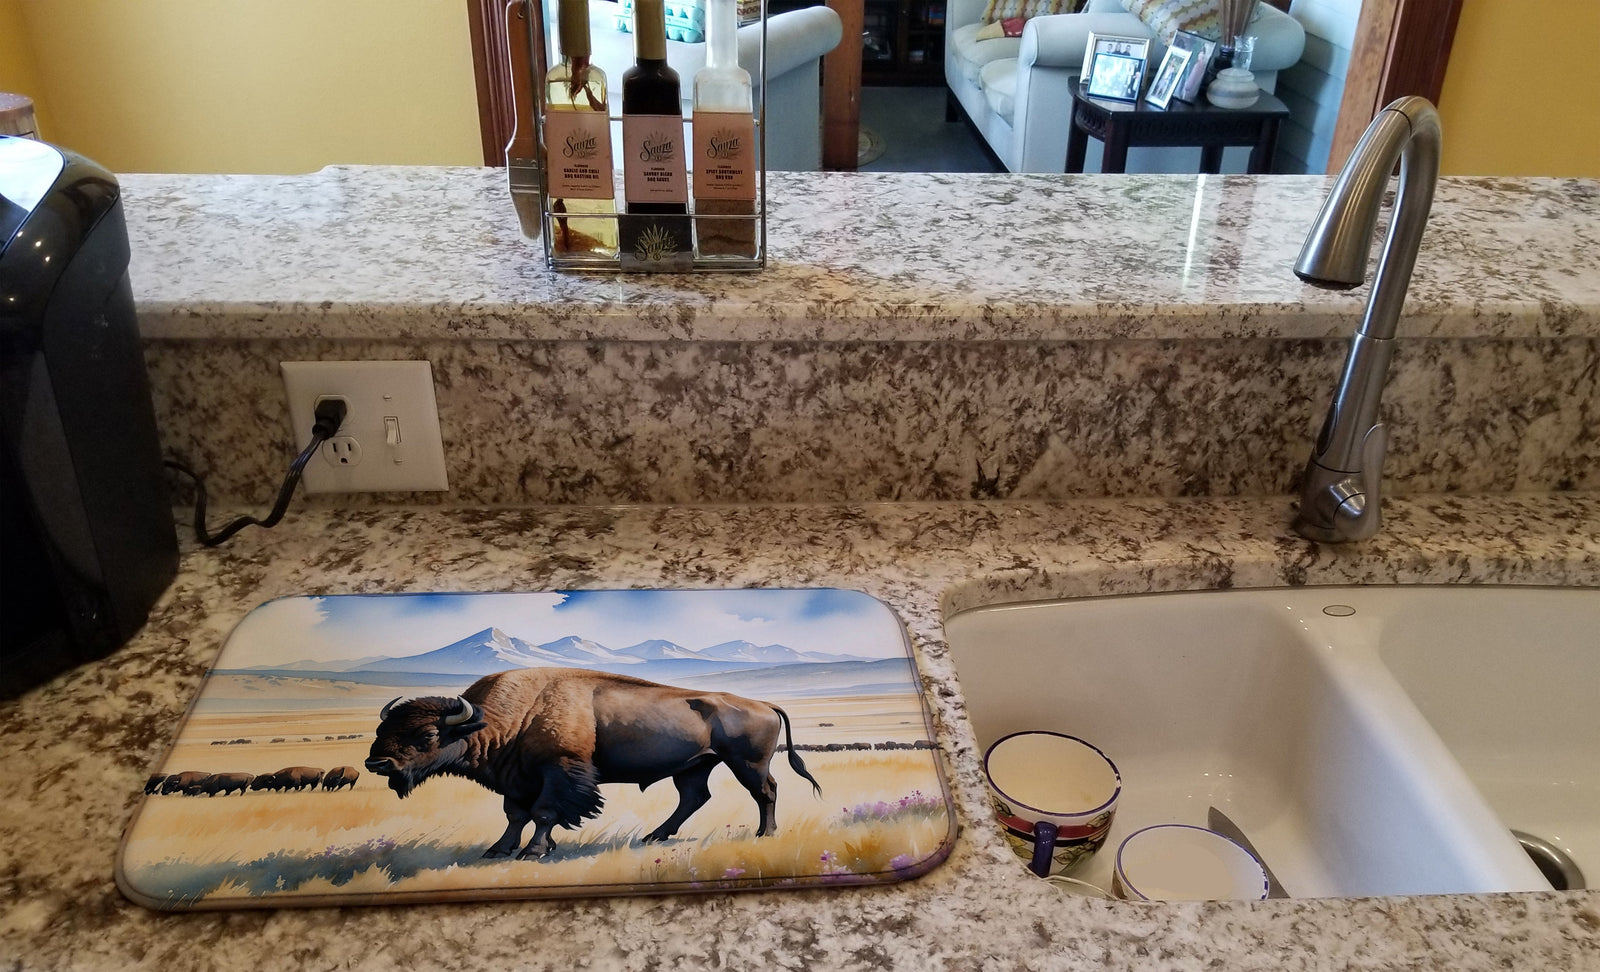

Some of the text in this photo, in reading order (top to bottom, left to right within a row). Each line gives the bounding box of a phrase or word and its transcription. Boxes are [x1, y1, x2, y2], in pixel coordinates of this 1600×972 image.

[562, 136, 596, 158] Sauza
[640, 140, 673, 161] Sauza
[707, 137, 739, 158] Sauza
